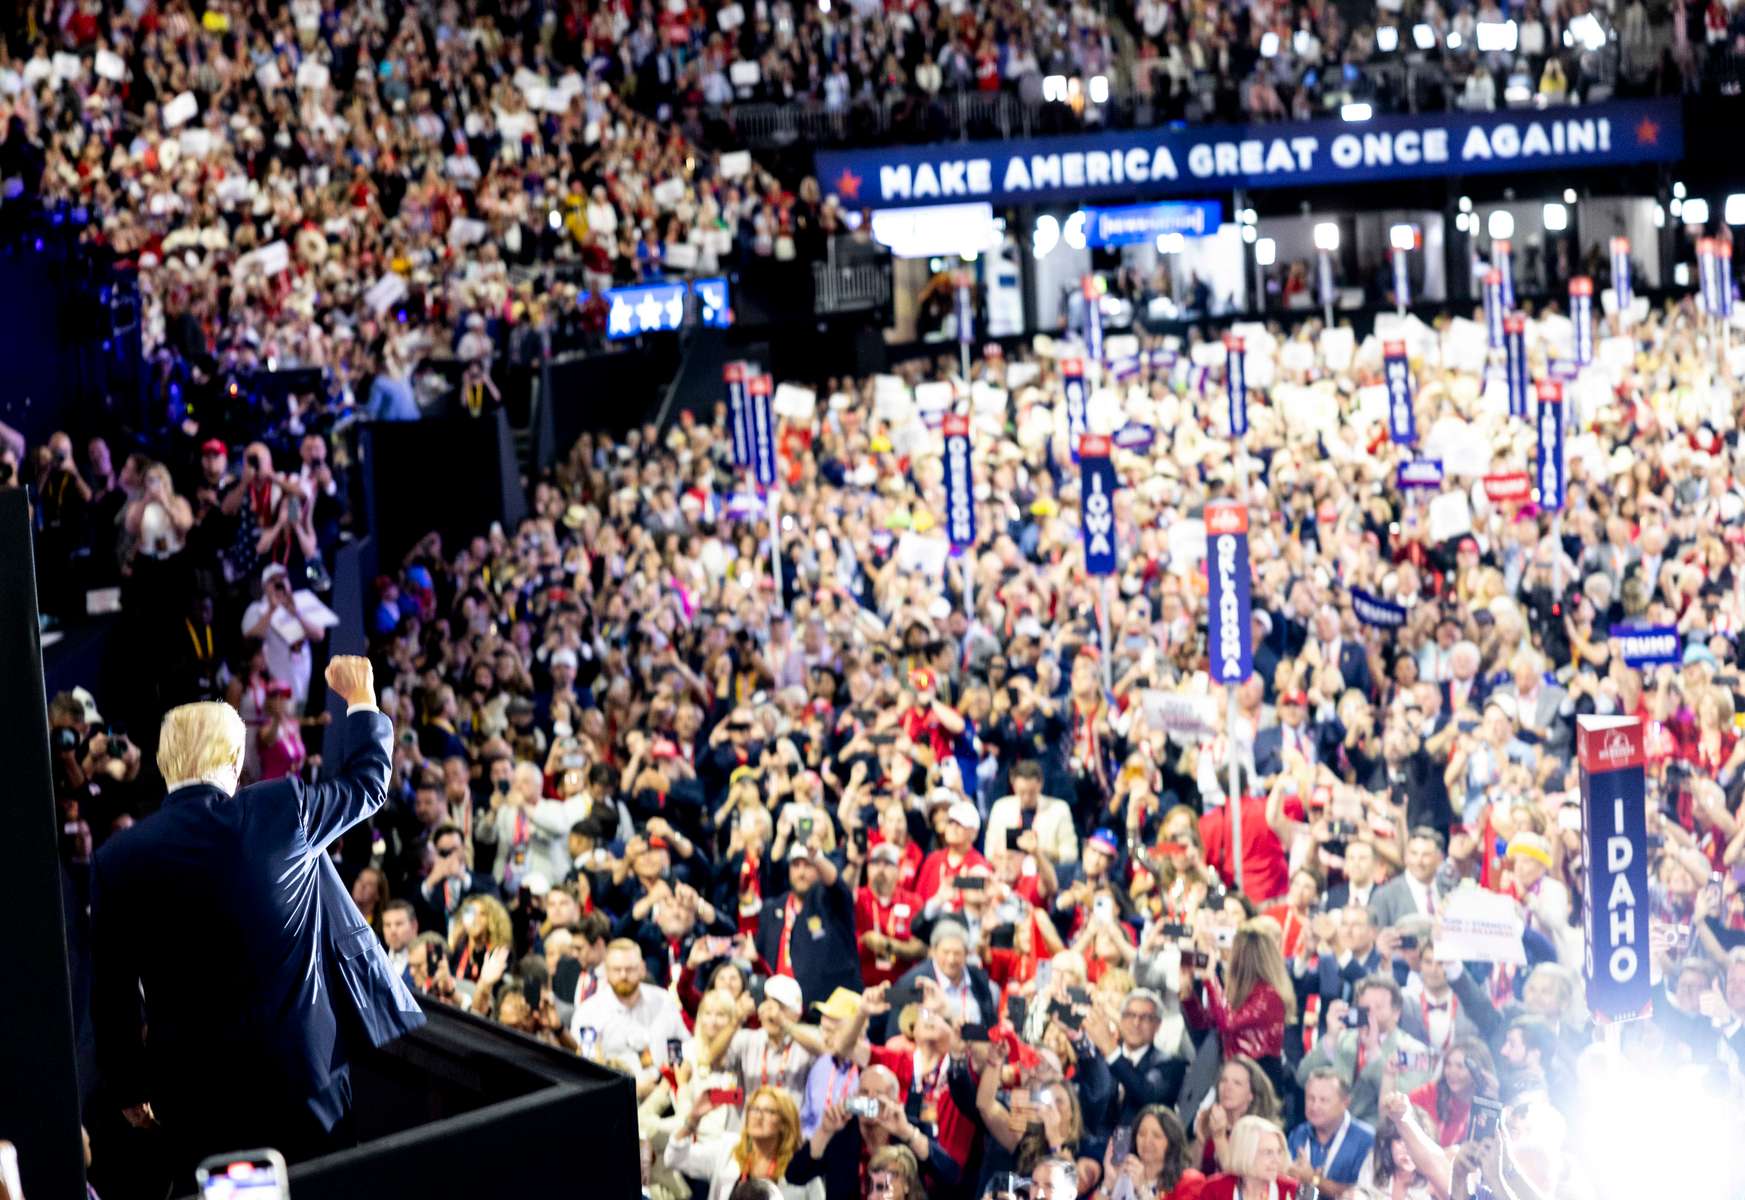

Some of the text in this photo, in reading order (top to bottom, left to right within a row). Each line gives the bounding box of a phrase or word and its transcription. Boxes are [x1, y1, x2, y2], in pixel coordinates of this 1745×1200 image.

[879, 118, 1611, 199] MAKE AMERICA GREAT ONCE AGAIN!
[948, 436, 971, 541] OREGON
[1086, 472, 1112, 555] IOWA
[1217, 534, 1241, 678] OKLAHOMA
[1607, 798, 1638, 983] IDAHO
